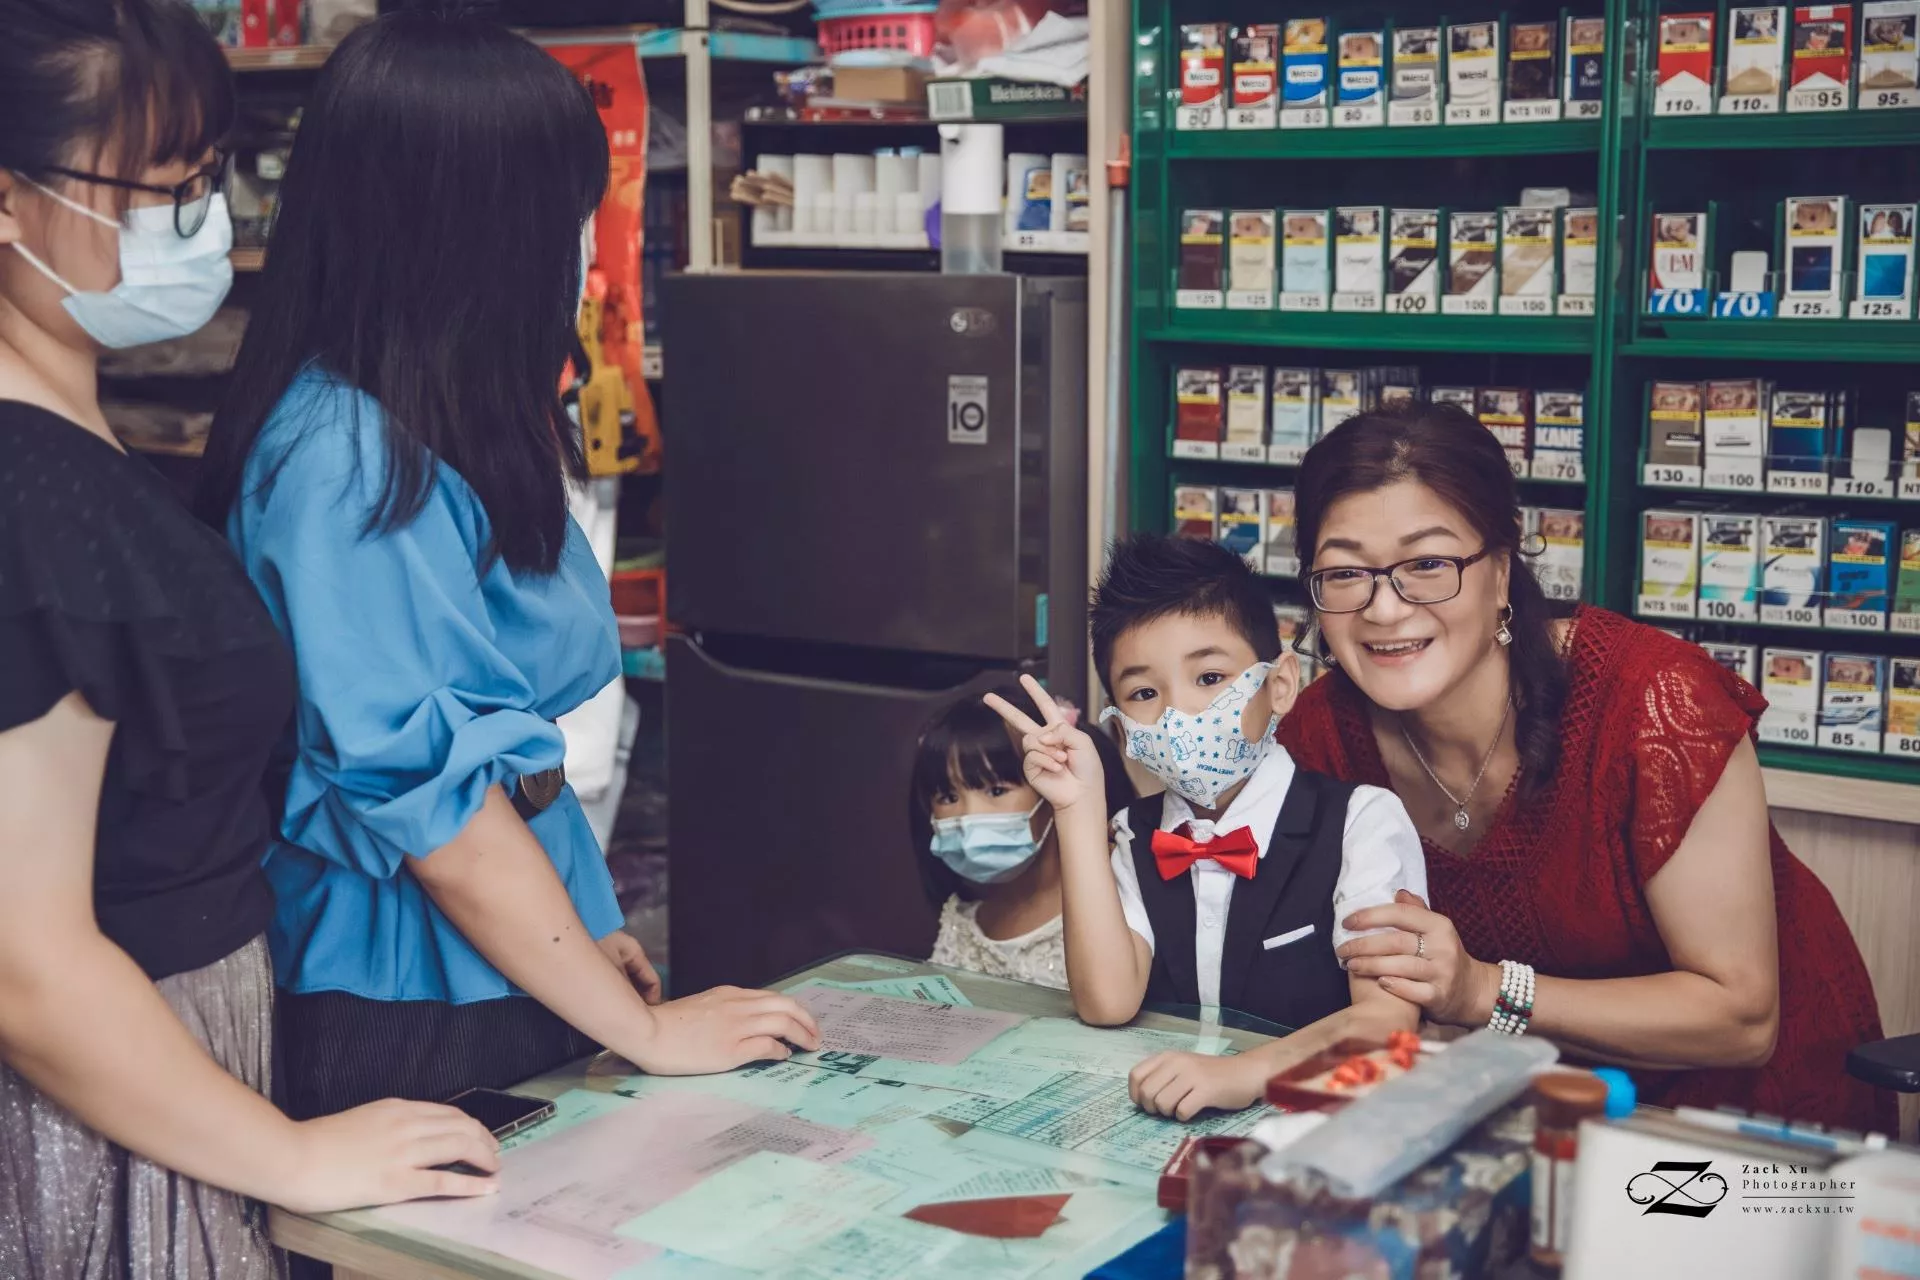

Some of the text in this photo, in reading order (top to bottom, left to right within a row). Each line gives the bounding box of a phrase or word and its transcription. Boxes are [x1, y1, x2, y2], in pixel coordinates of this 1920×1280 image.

[1732, 98, 1762, 111] 110
[1817, 91, 1842, 107] 95
[1877, 93, 1900, 106] 95
[1666, 100, 1694, 112] 110
[1395, 296, 1426, 311] 100
[1653, 289, 1694, 314] 70
[1719, 291, 1761, 317] 70
[1793, 303, 1823, 315] 125
[1863, 303, 1893, 316] 125
[1556, 464, 1577, 478] 70
[1653, 469, 1684, 483] 130
[1728, 475, 1754, 487] 100
[1801, 479, 1822, 489] 110
[1845, 481, 1875, 495] 110
[1706, 602, 1736, 618] 100
[1786, 610, 1813, 622] 100
[1851, 614, 1877, 626] 100
[1783, 728, 1809, 740] 100
[1832, 732, 1854, 746] 85
